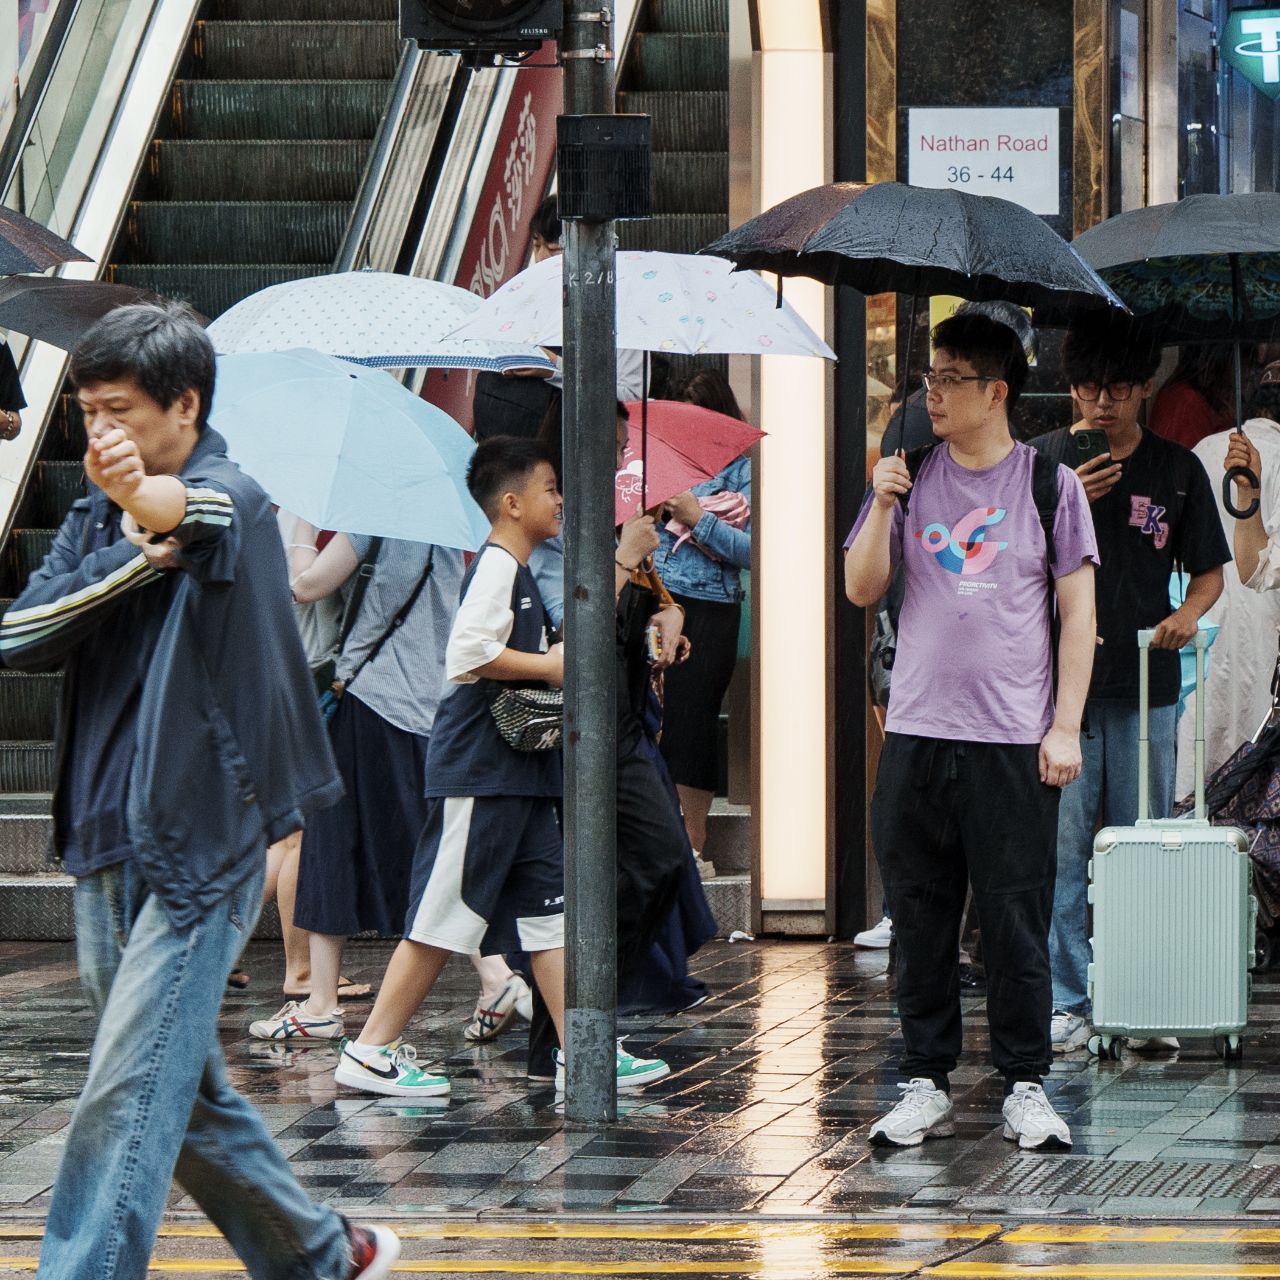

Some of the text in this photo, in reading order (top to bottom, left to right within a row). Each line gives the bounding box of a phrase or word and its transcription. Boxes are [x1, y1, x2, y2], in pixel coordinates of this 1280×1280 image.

[919, 134, 1049, 152] Nathan Road
[947, 166, 971, 183] 36
[990, 166, 1015, 183] 44
